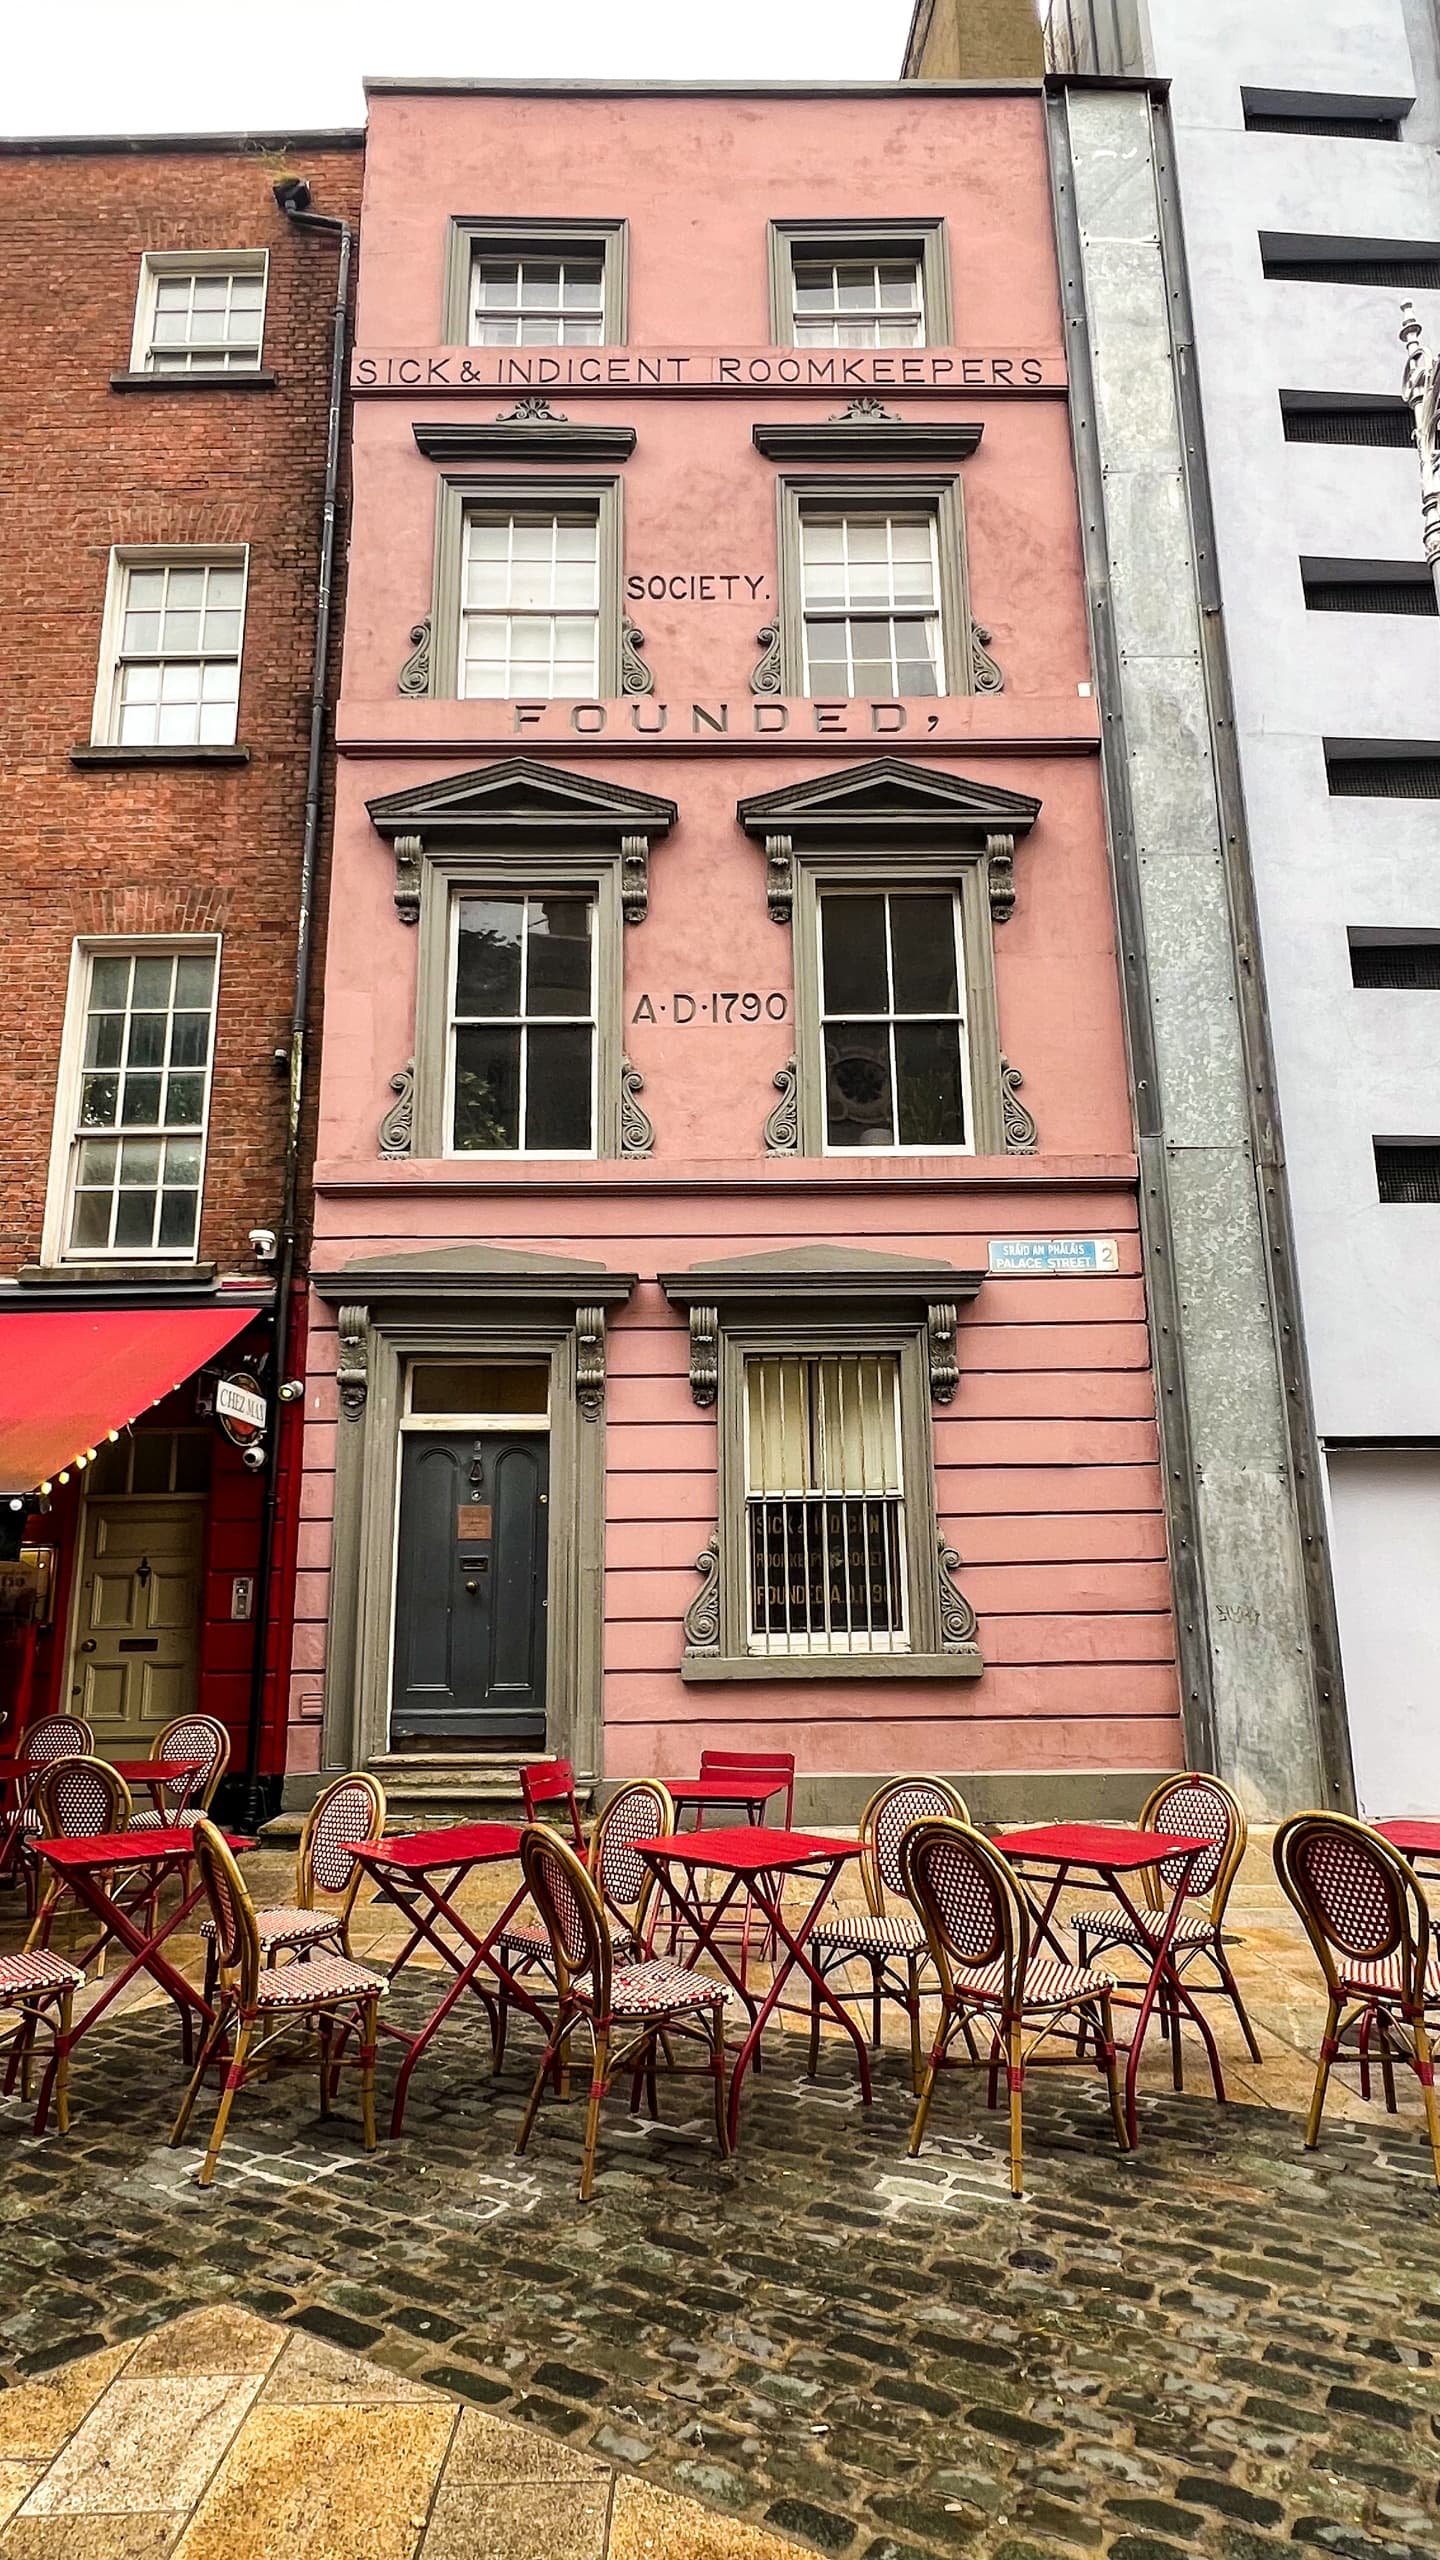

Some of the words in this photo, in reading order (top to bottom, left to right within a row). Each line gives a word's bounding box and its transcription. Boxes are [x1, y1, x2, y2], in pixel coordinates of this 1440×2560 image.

[499, 358, 691, 384] INDIGENT
[719, 358, 1043, 385] ROOMKEEPERS
[626, 575, 771, 600] SOCIETY.
[513, 703, 940, 733] FOUNDED,
[1032, 1244, 1045, 1256] AN
[1102, 1247, 1113, 1262] 2
[996, 1257, 1042, 1269] PALACE
[1047, 1256, 1091, 1268] STREET
[220, 1389, 246, 1413] CHEZ
